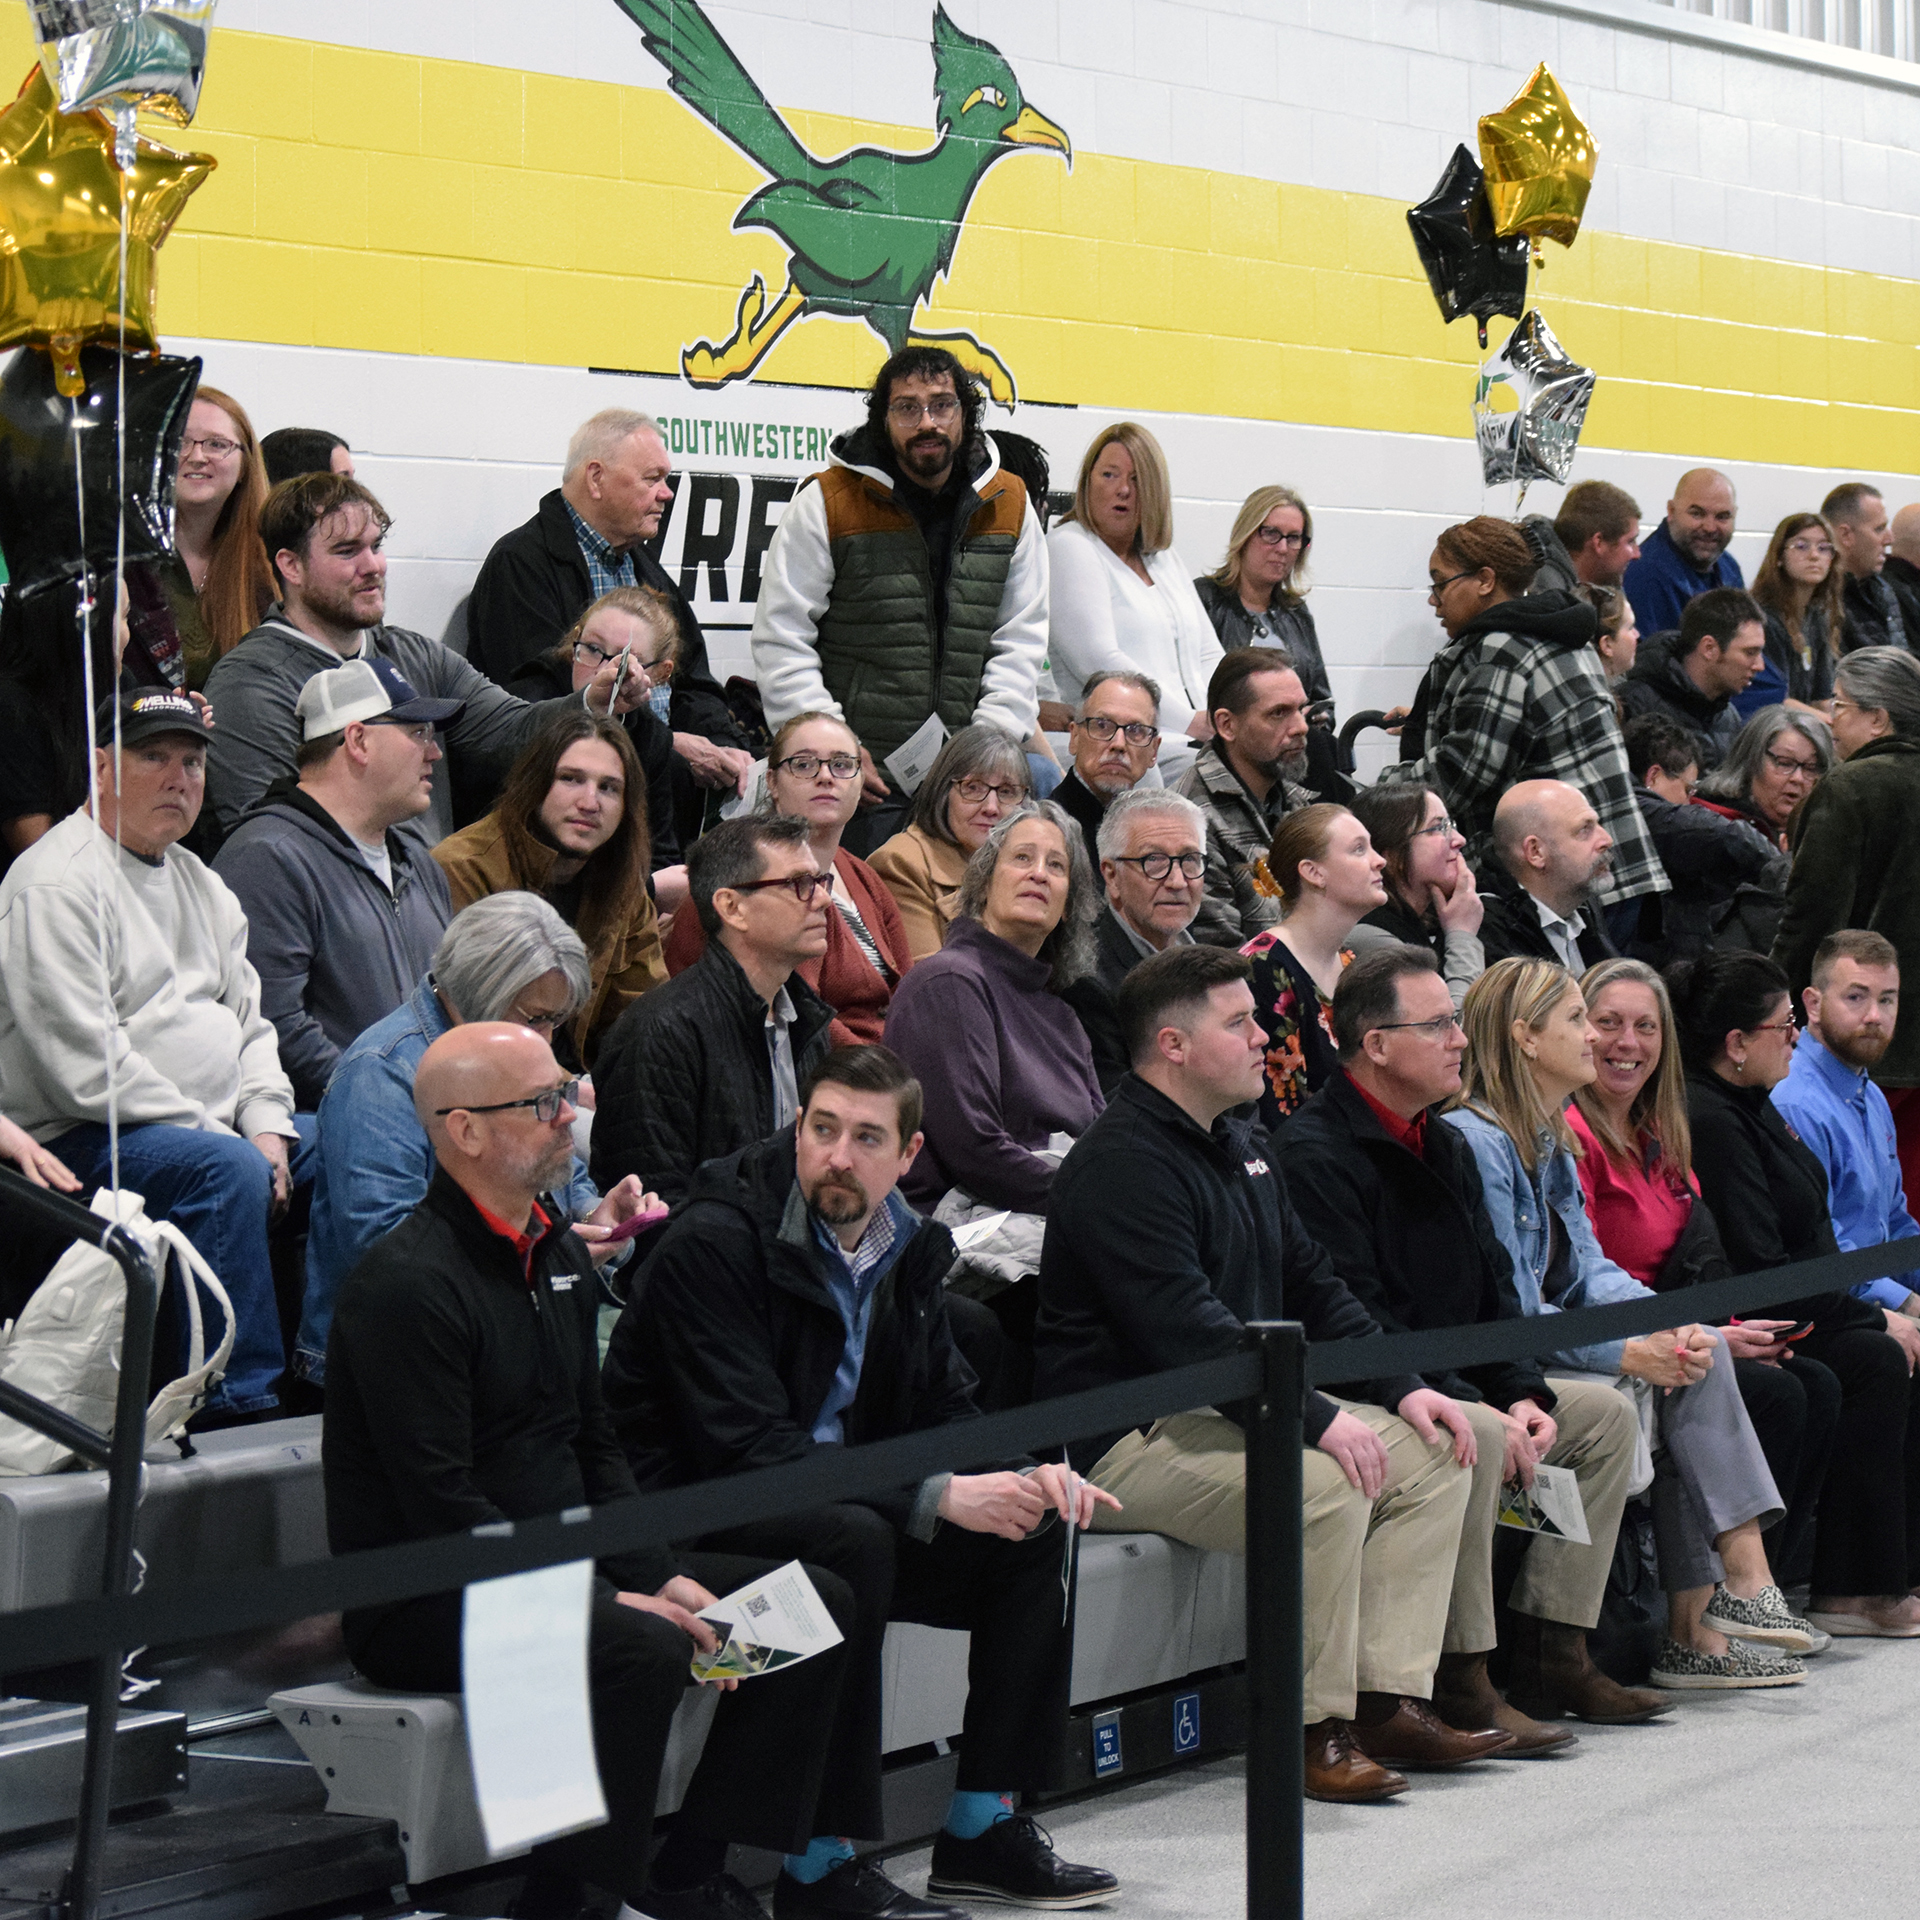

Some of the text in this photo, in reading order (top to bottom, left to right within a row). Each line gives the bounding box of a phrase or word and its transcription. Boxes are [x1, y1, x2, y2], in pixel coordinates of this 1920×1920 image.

[655, 416, 832, 462] SOUTHWESTERN
[139, 694, 194, 711] MELLING
[298, 1710, 311, 1726] A
[1099, 1729, 1113, 1740] PULL
[1103, 1742, 1112, 1752] TO
[1097, 1753, 1120, 1767] UNLOCK
